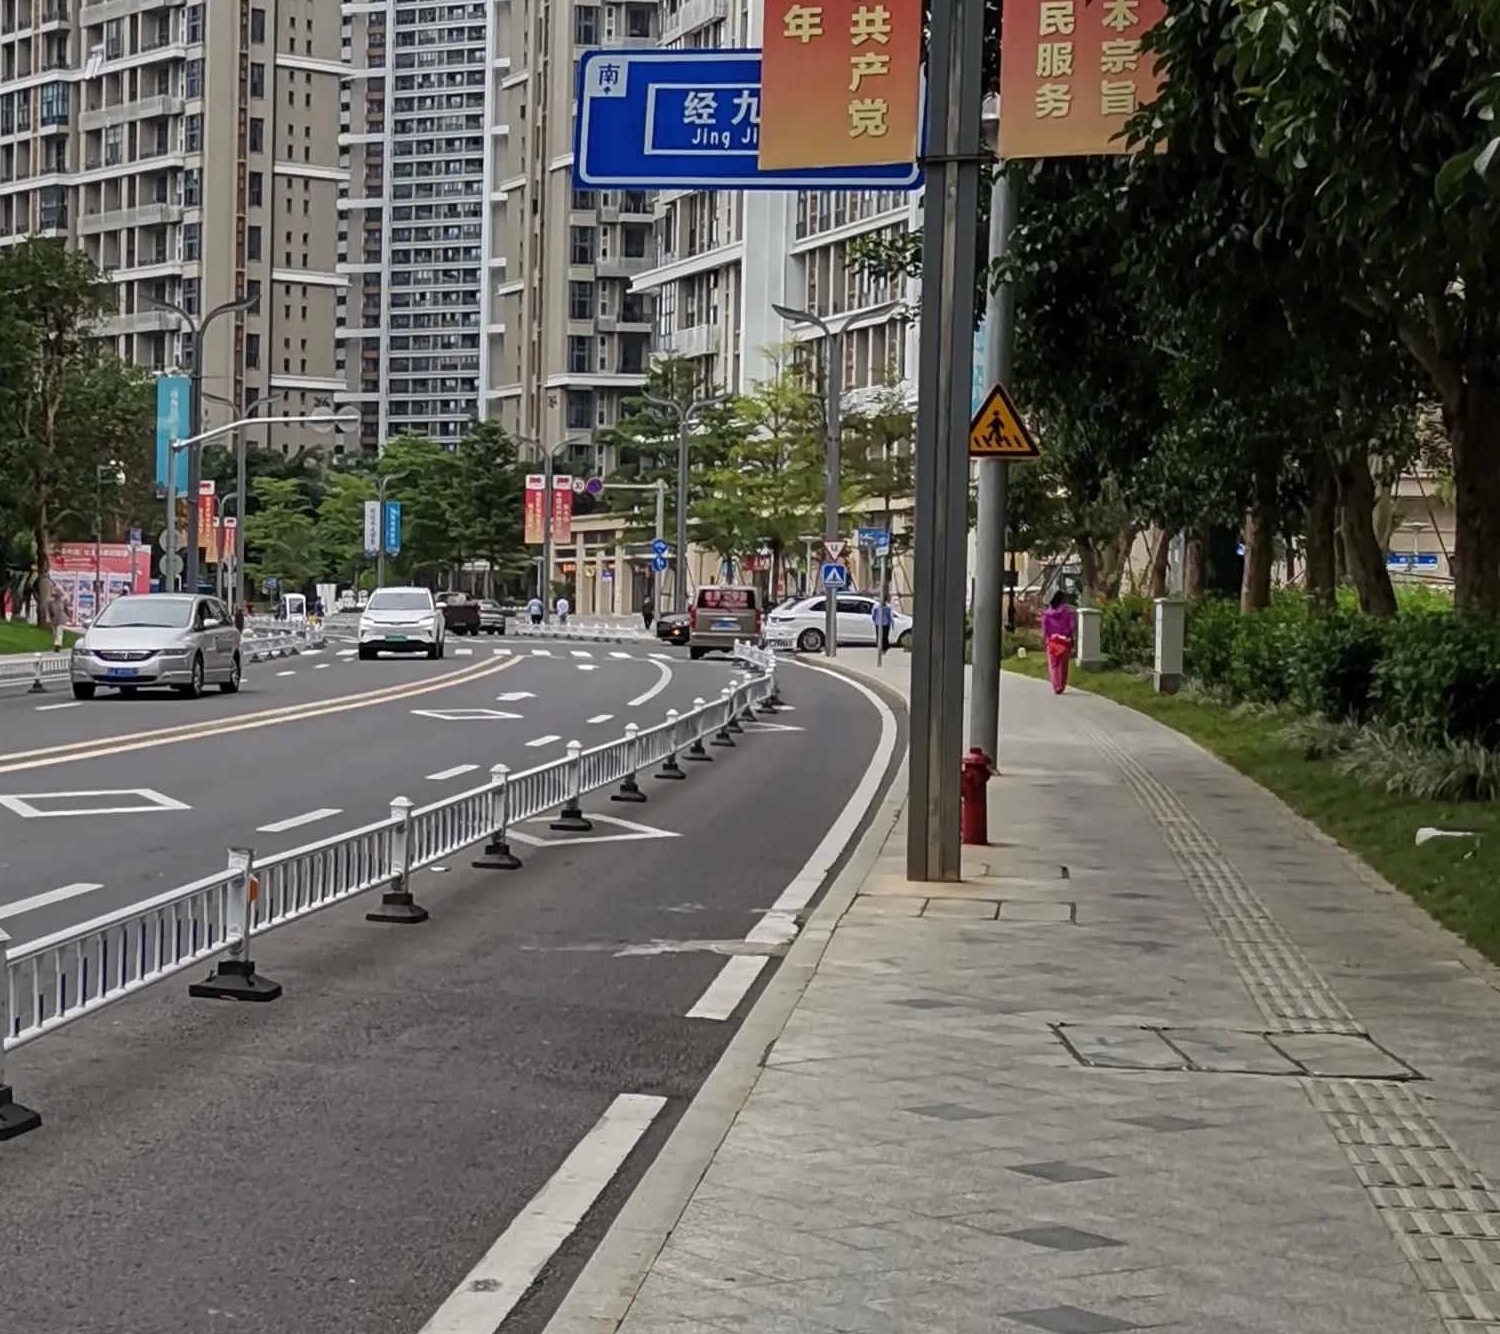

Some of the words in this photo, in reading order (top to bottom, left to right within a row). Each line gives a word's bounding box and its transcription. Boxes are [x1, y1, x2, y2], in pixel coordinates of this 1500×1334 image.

[598, 63, 620, 85] 南
[683, 90, 761, 126] 经九
[692, 127, 731, 148] Jing
